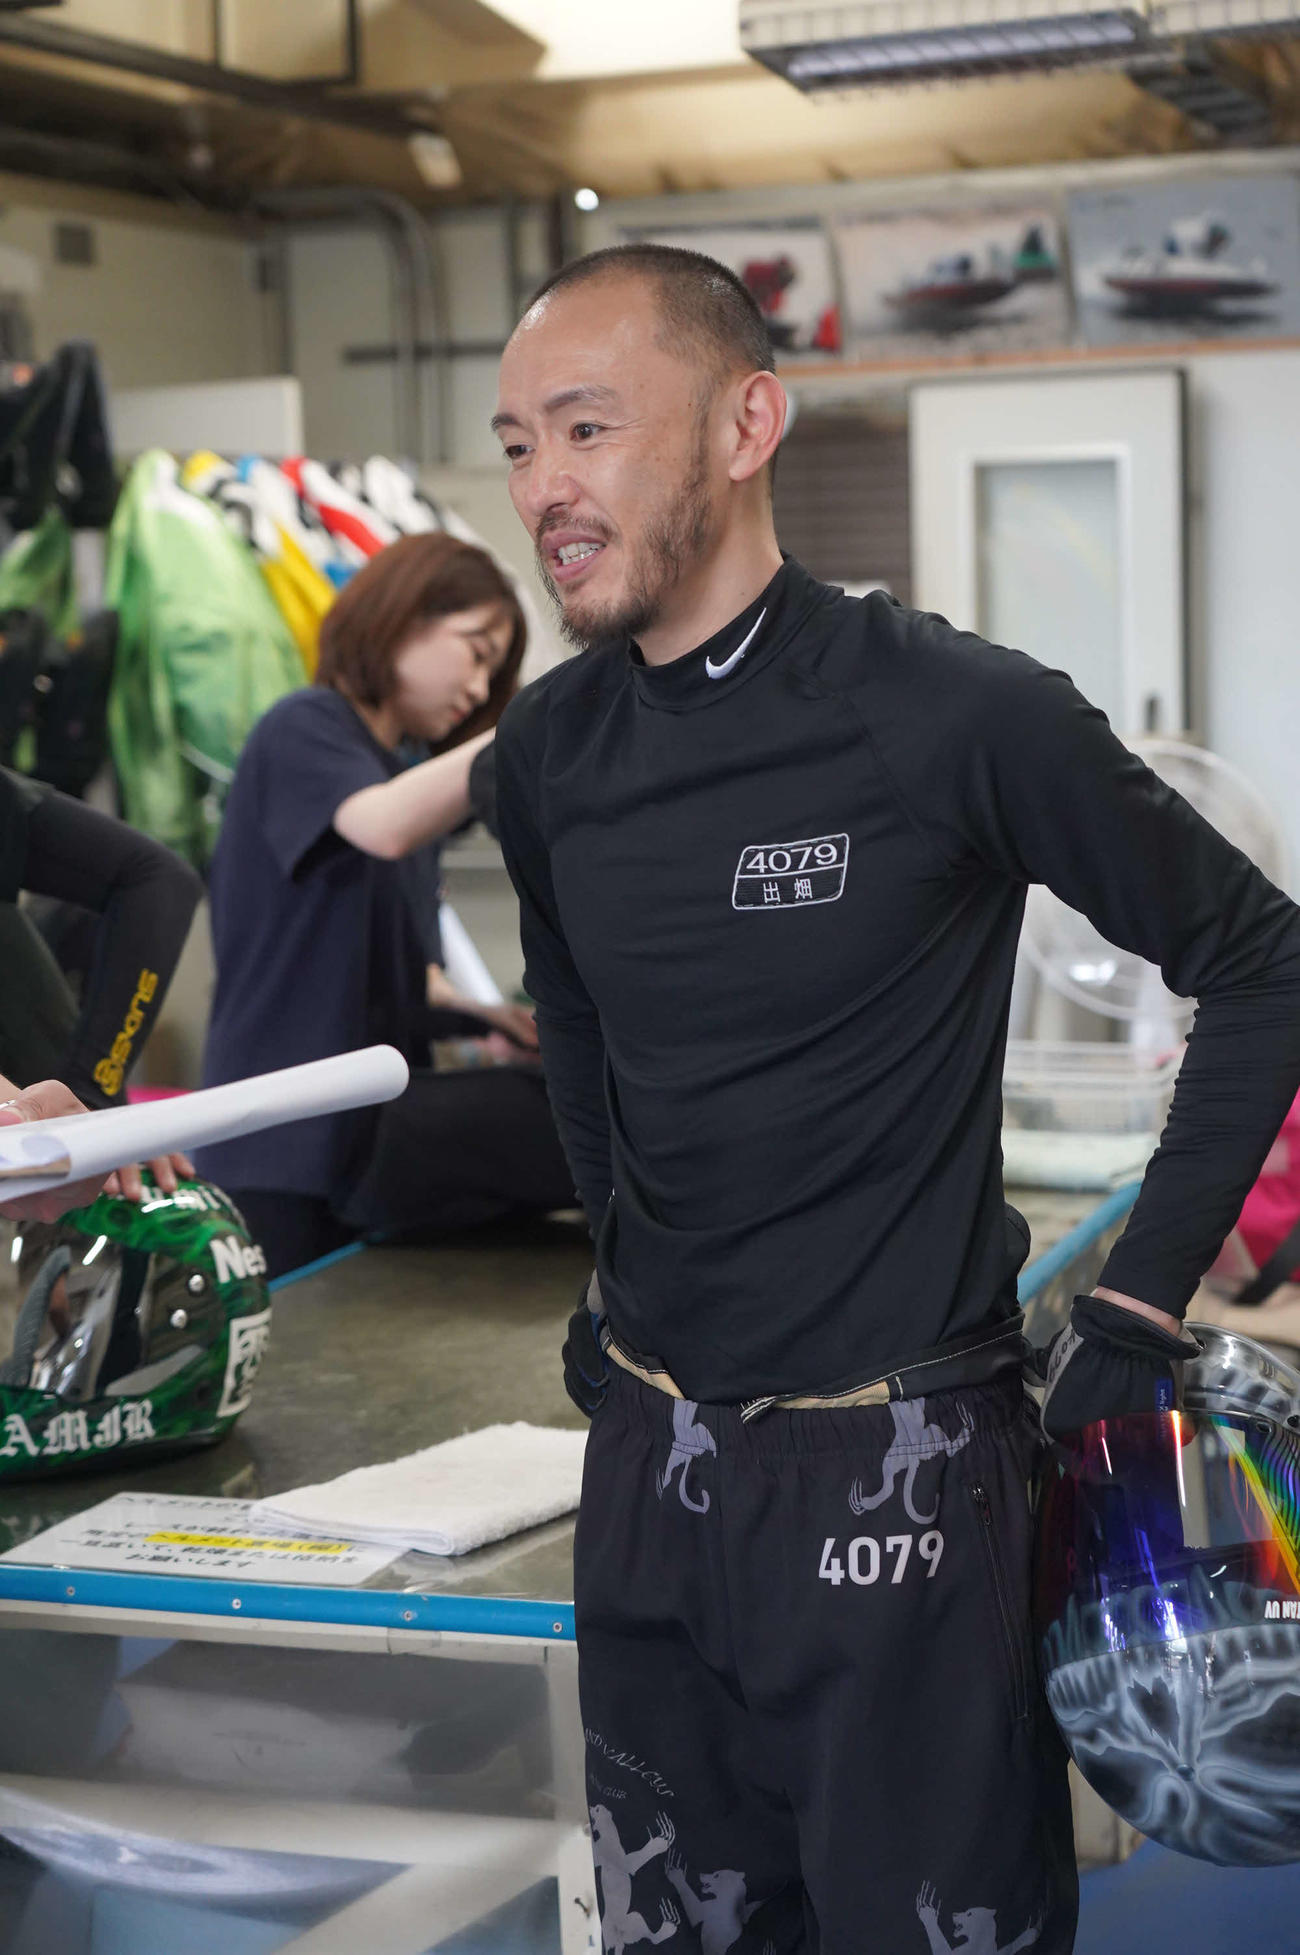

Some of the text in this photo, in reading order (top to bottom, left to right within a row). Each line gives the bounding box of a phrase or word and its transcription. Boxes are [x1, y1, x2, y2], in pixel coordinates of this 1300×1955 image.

[746, 843, 838, 873] 4079
[763, 877, 813, 903] 出畑
[818, 1529, 945, 1586] 4079
[1263, 1600, 1281, 1620] UV
